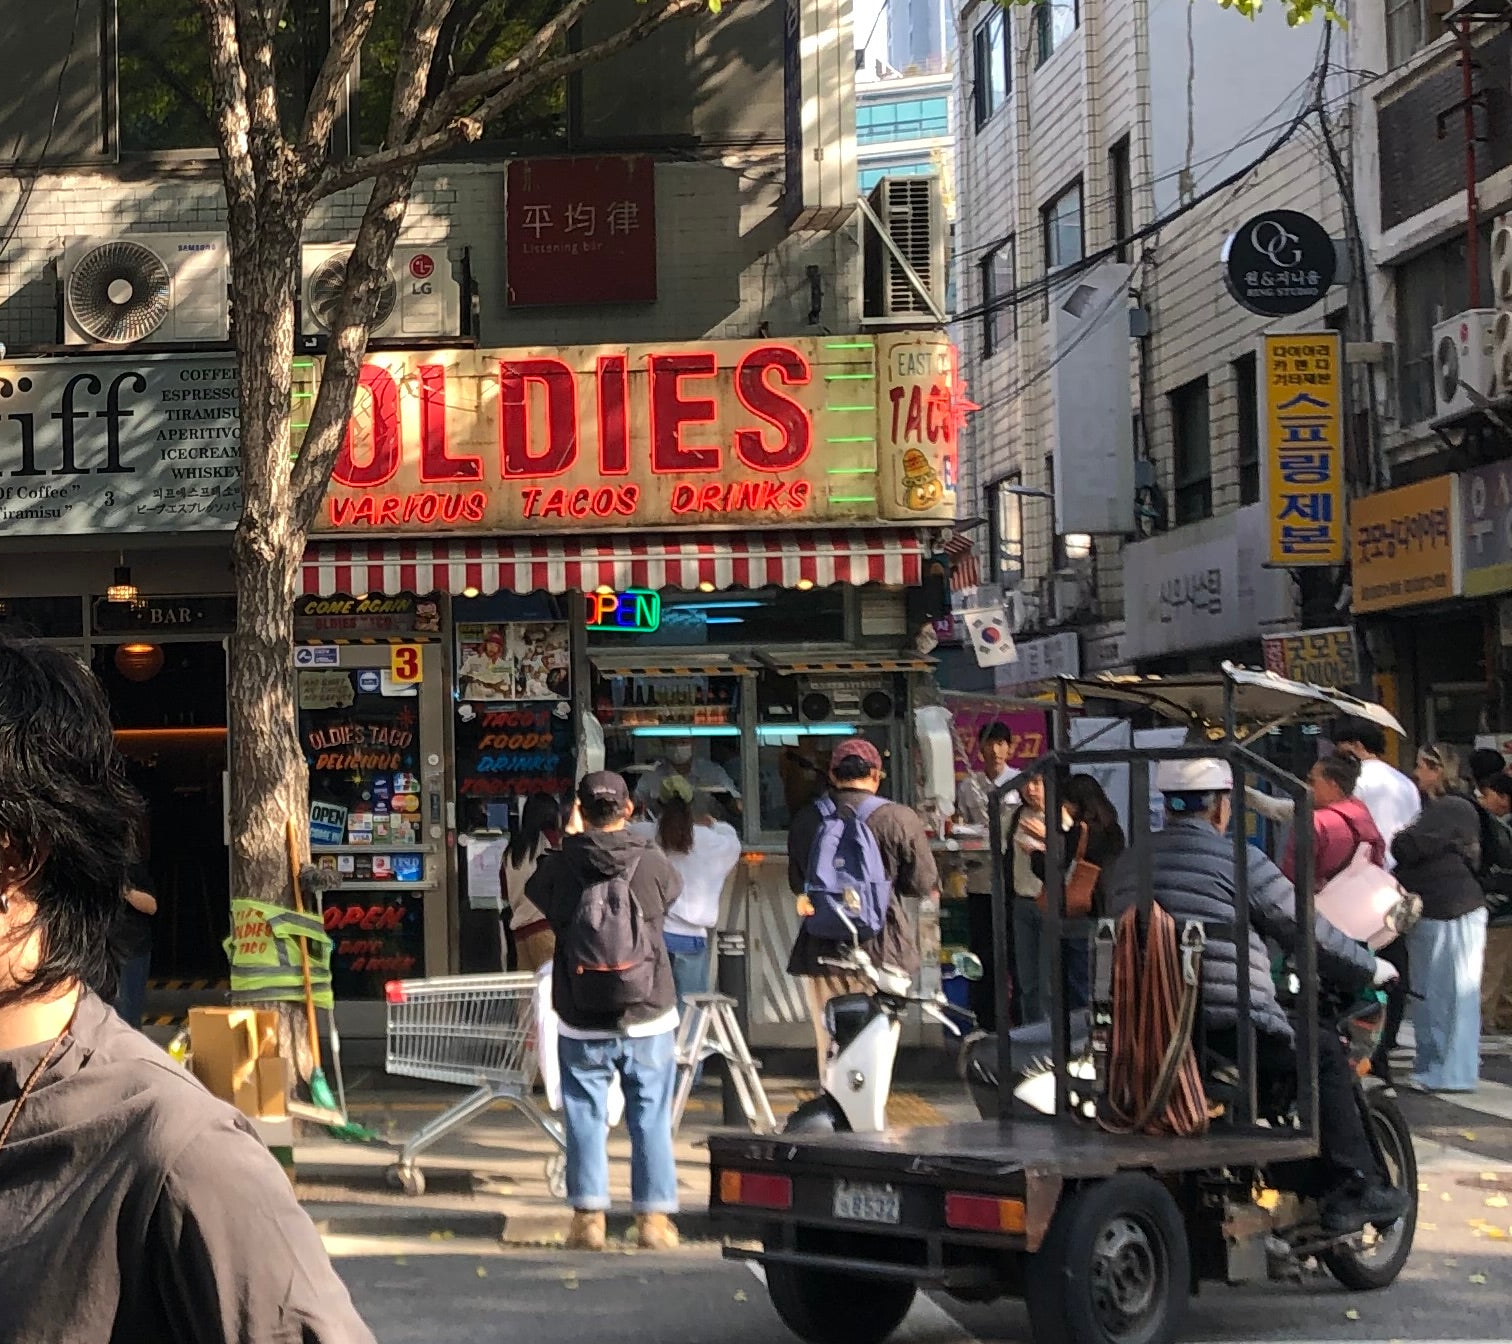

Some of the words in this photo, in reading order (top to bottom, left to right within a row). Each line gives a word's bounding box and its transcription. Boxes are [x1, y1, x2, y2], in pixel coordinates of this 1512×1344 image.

[522, 200, 640, 239] 平均律
[412, 282, 432, 295] LG
[898, 352, 933, 377] EAST
[331, 347, 812, 488] OLDIES
[17, 485, 68, 500] Coffee
[329, 490, 487, 527] VARIOUS
[521, 482, 641, 518] TACOS
[670, 480, 812, 514] DRINKS
[150, 607, 192, 624] BAR
[304, 599, 355, 616] COME
[585, 593, 659, 628] OPEN
[395, 647, 419, 680] 3
[308, 726, 365, 750] OLDIES
[368, 725, 413, 749] TACO
[311, 805, 346, 826] OPEN
[323, 906, 406, 930] OPEN
